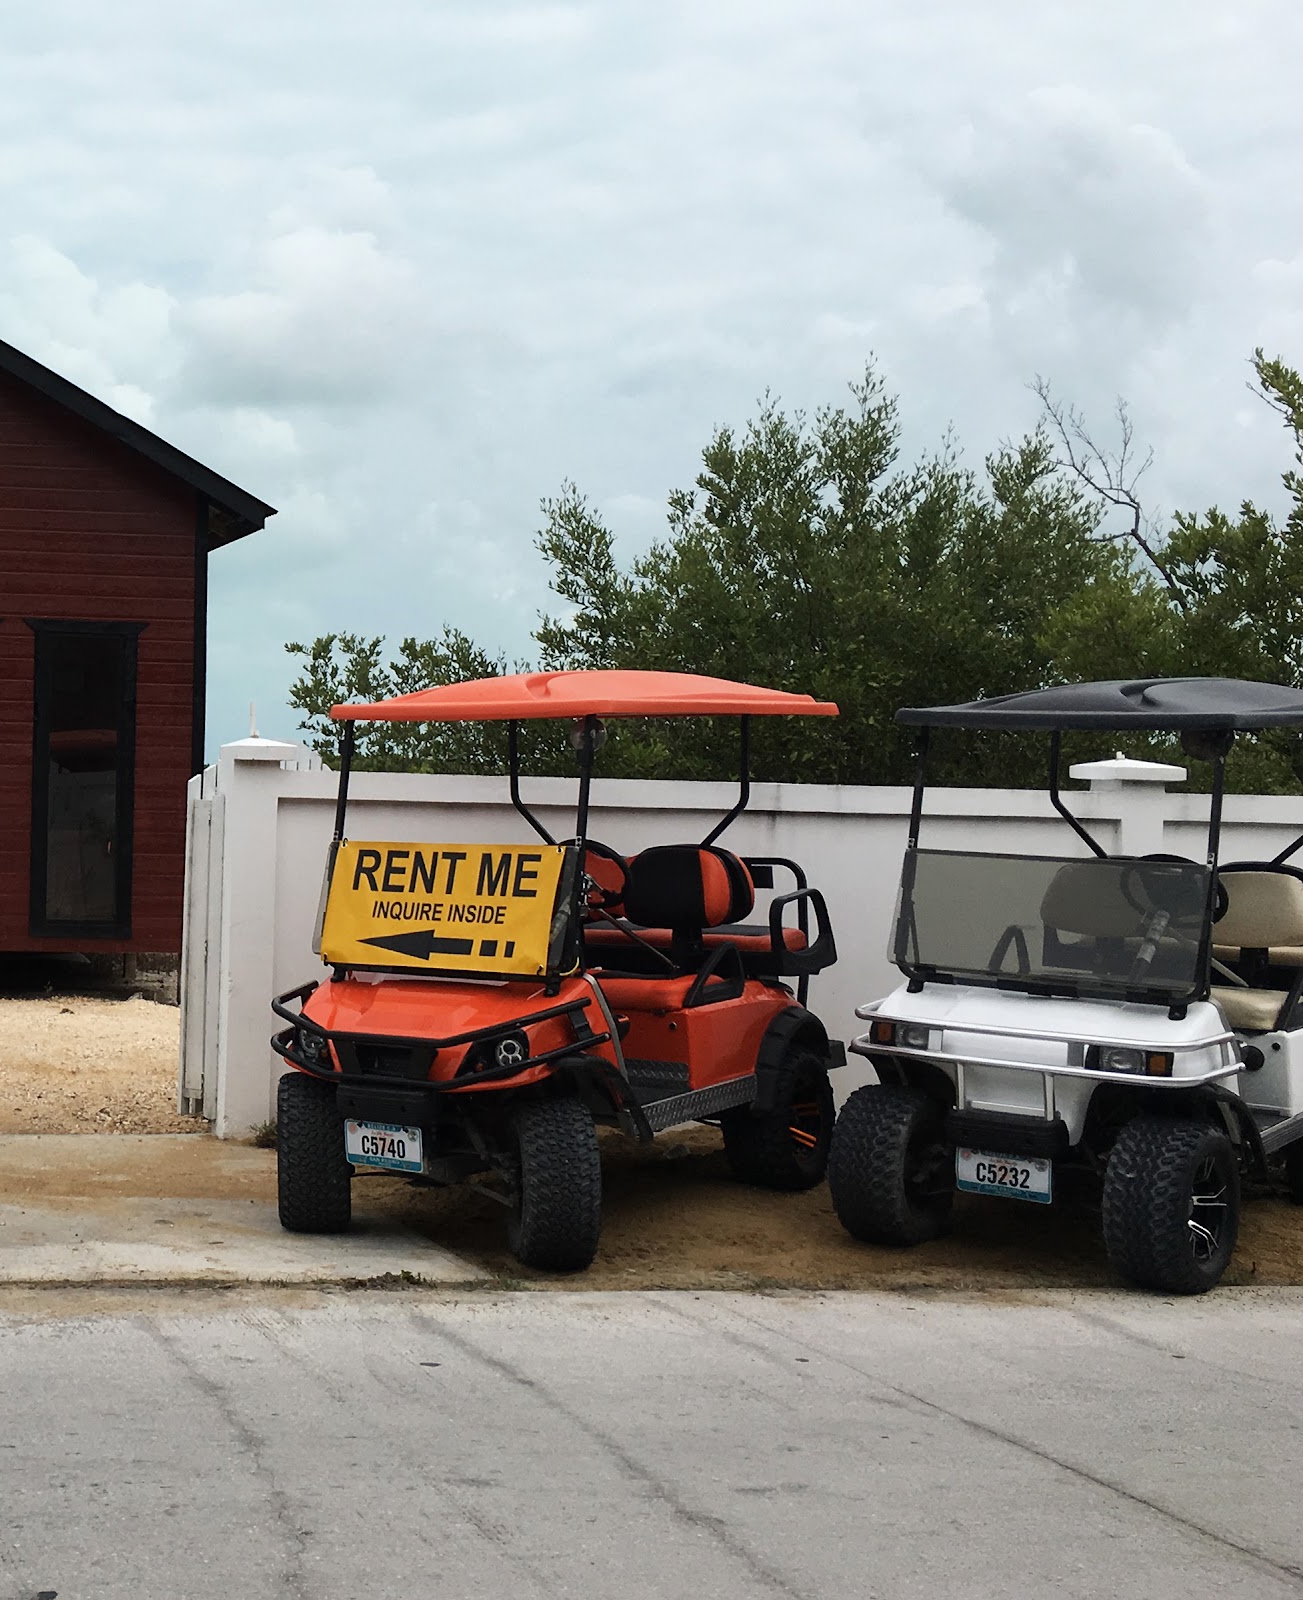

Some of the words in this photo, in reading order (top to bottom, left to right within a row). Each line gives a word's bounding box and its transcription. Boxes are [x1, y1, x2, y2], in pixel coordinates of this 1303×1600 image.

[352, 849, 467, 895] RENT
[476, 852, 542, 898] ME
[372, 900, 444, 922] INQUIRE
[447, 904, 507, 924] INSIDE
[362, 1136, 405, 1158] C5740
[976, 1162, 1030, 1189] C5232
